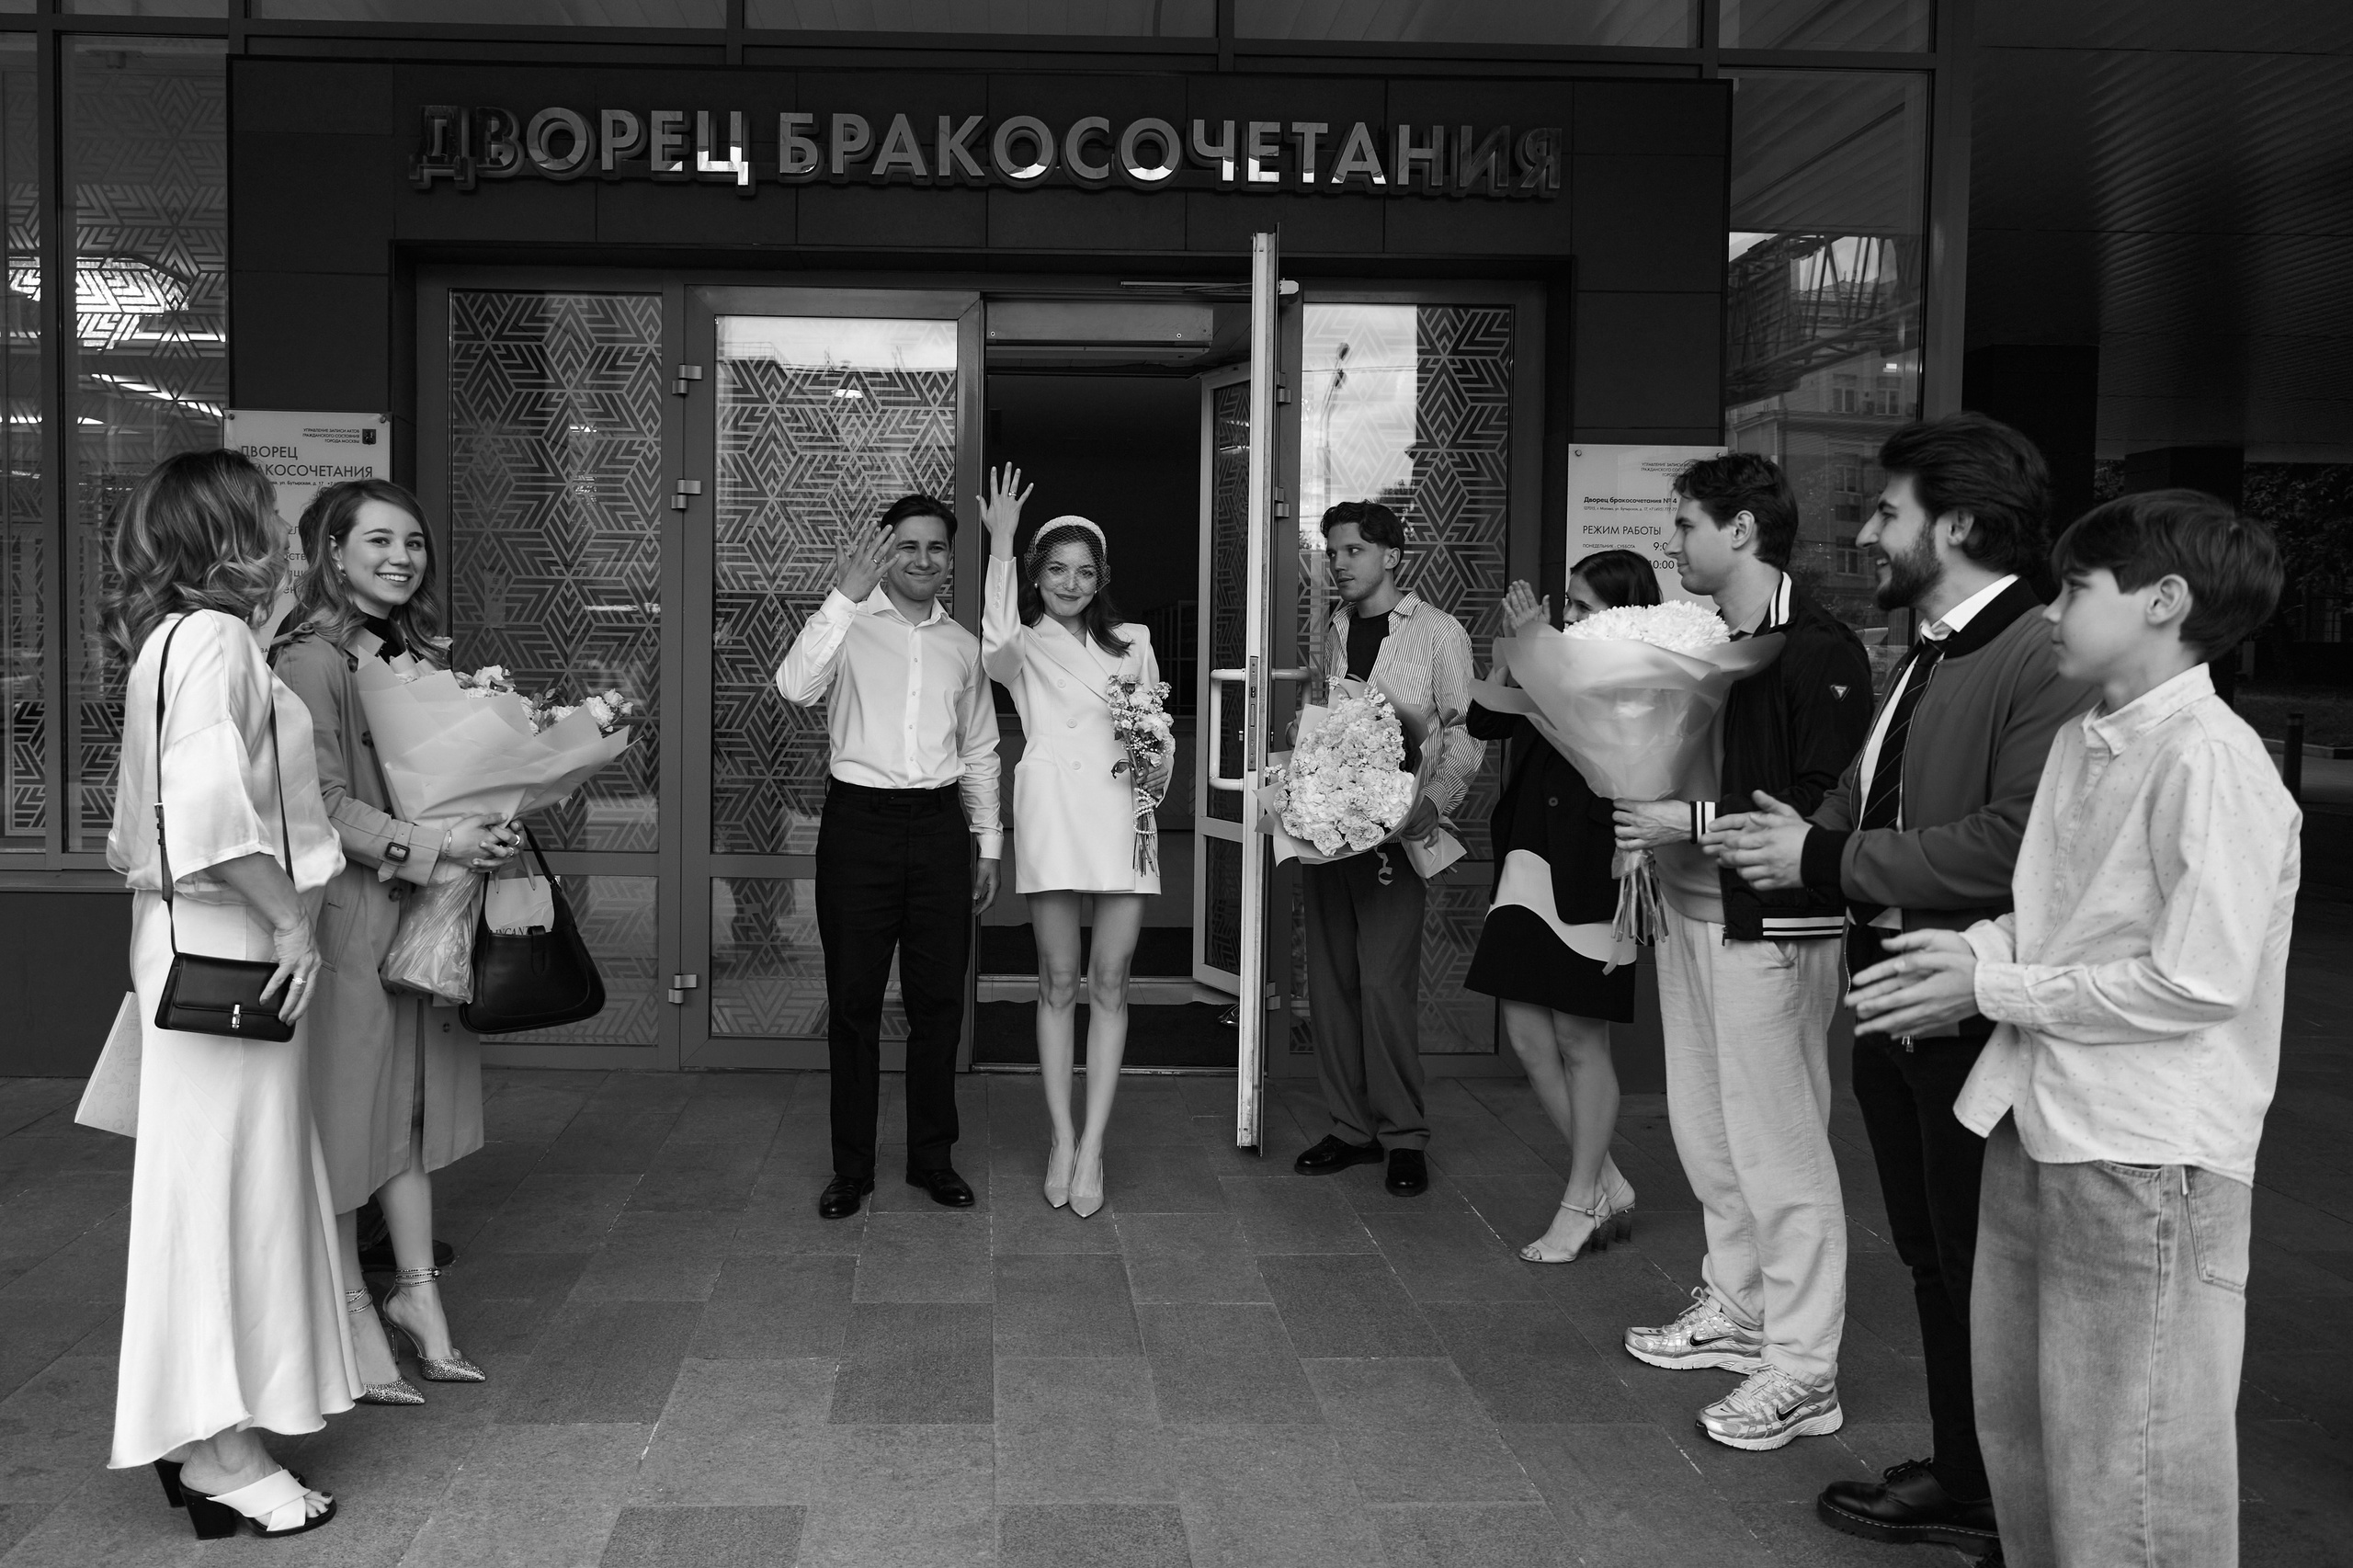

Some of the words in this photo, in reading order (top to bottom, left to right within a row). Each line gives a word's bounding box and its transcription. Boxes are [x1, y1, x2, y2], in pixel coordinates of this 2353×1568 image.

[410, 105, 750, 189] ДВОРЕЦ
[779, 112, 1563, 192] БРАКОСОЧЕТАНИЯ
[241, 446, 299, 460] ДВОРЕЦ
[257, 464, 373, 478] АКОСОЧЕТАНИЯ
[1584, 496, 1608, 505] Дворец
[1583, 525, 1620, 535] РЕЖИМ
[1622, 526, 1662, 536] РАБОТЫ
